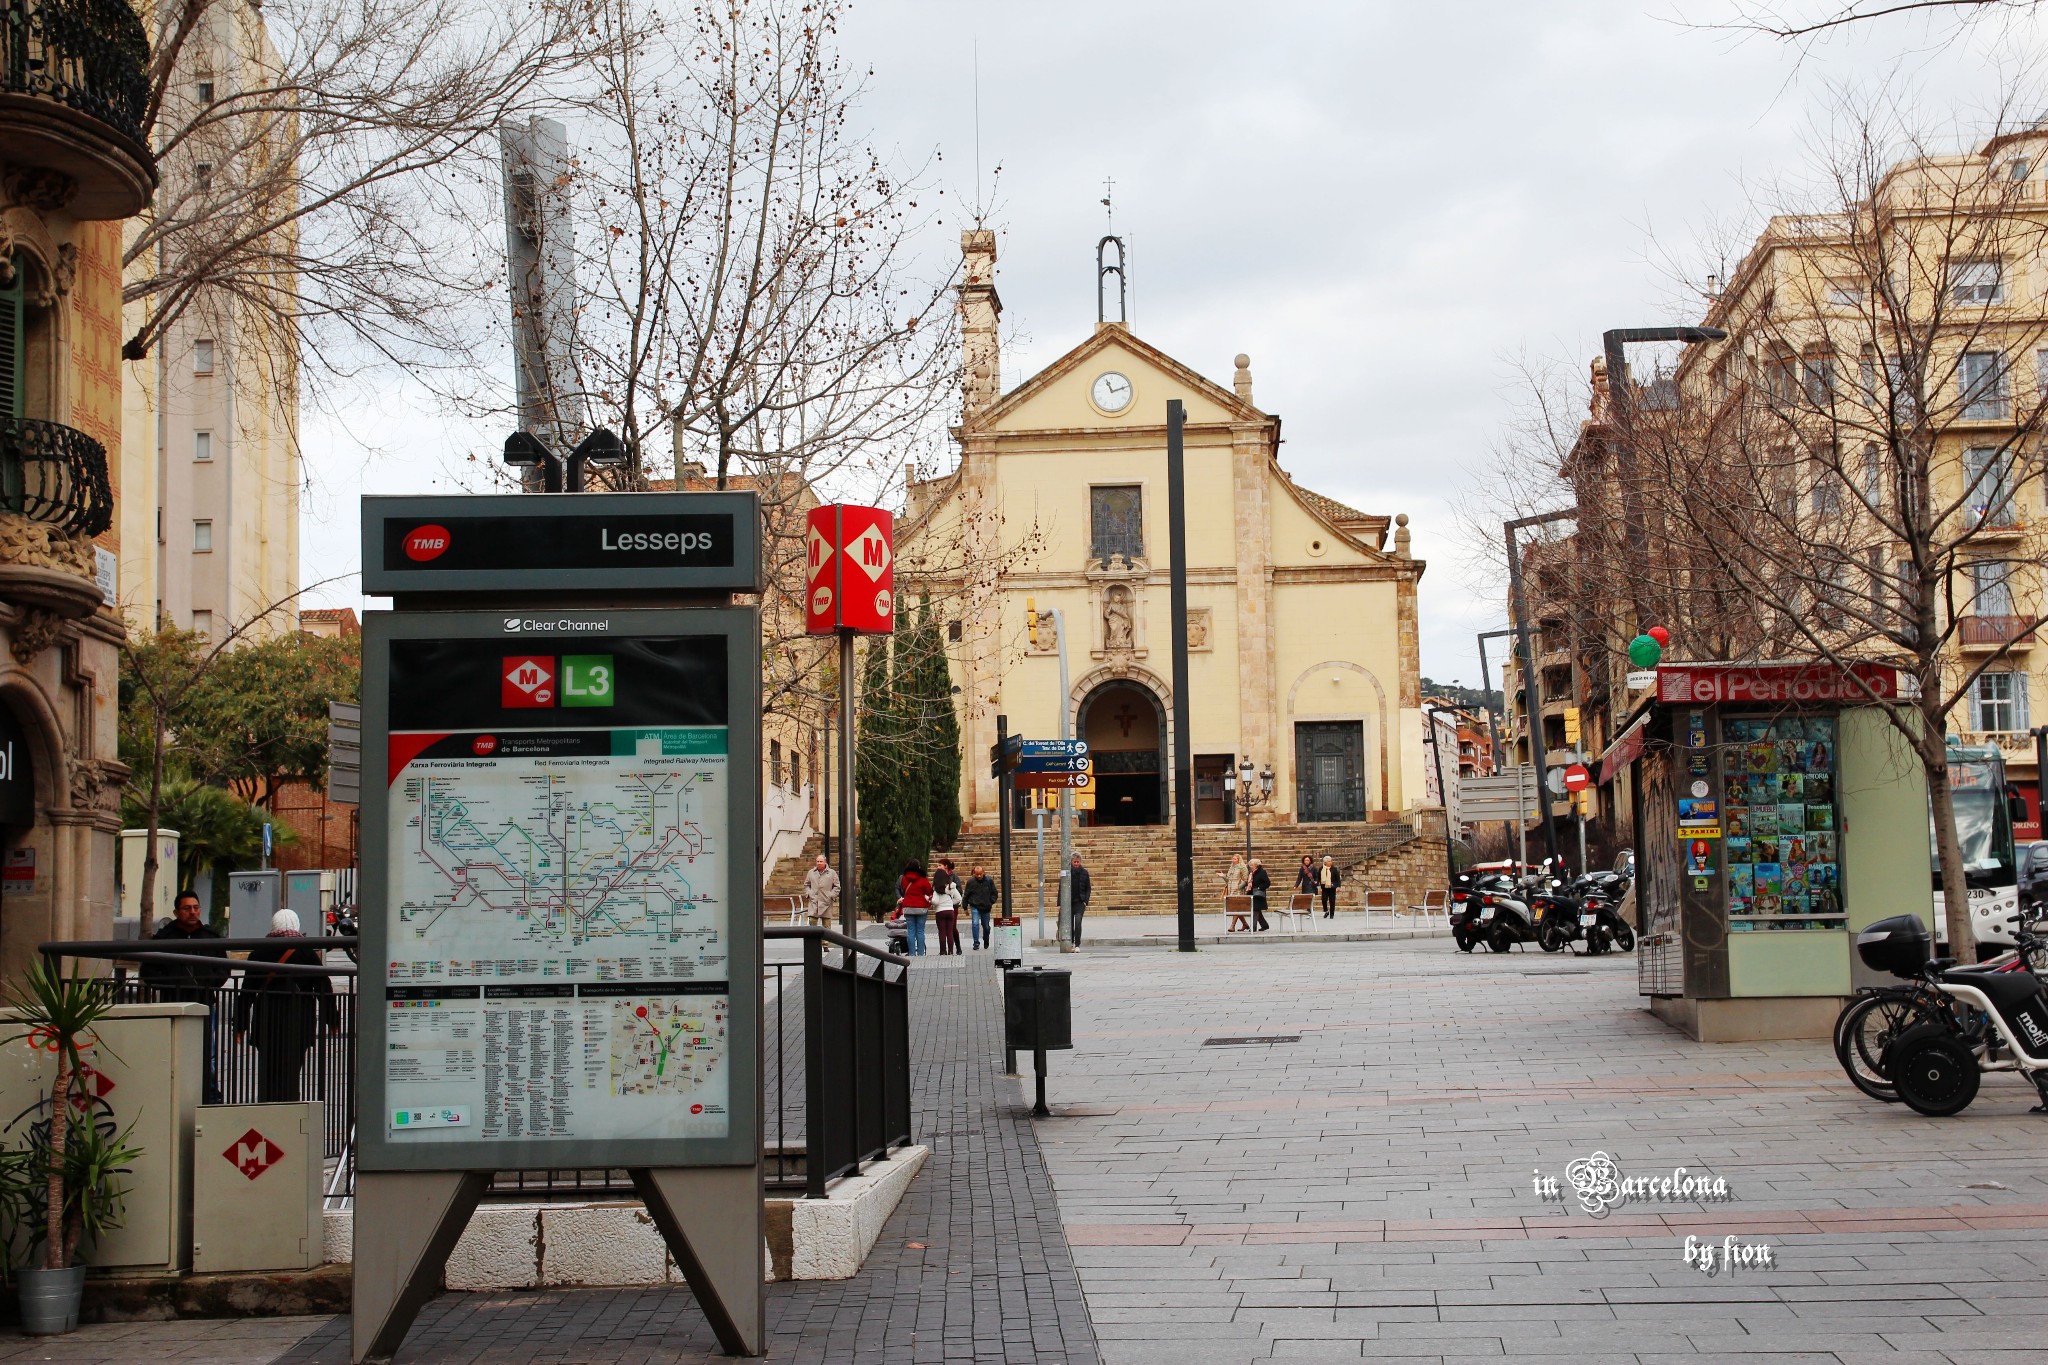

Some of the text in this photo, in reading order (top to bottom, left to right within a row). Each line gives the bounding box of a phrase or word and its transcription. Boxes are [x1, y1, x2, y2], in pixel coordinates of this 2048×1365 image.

[413, 538, 445, 550] TMB
[602, 528, 713, 554] Lesseps
[808, 539, 820, 568] M
[864, 538, 882, 568] M
[815, 596, 829, 606] TMB
[879, 599, 890, 608] TMB
[523, 620, 608, 631] Clear Channel
[519, 669, 538, 684] M
[566, 666, 610, 696] L3
[1693, 670, 1888, 700] el Periódico
[502, 736, 580, 746] Transports Metropolitans
[1968, 890, 1984, 899] 230
